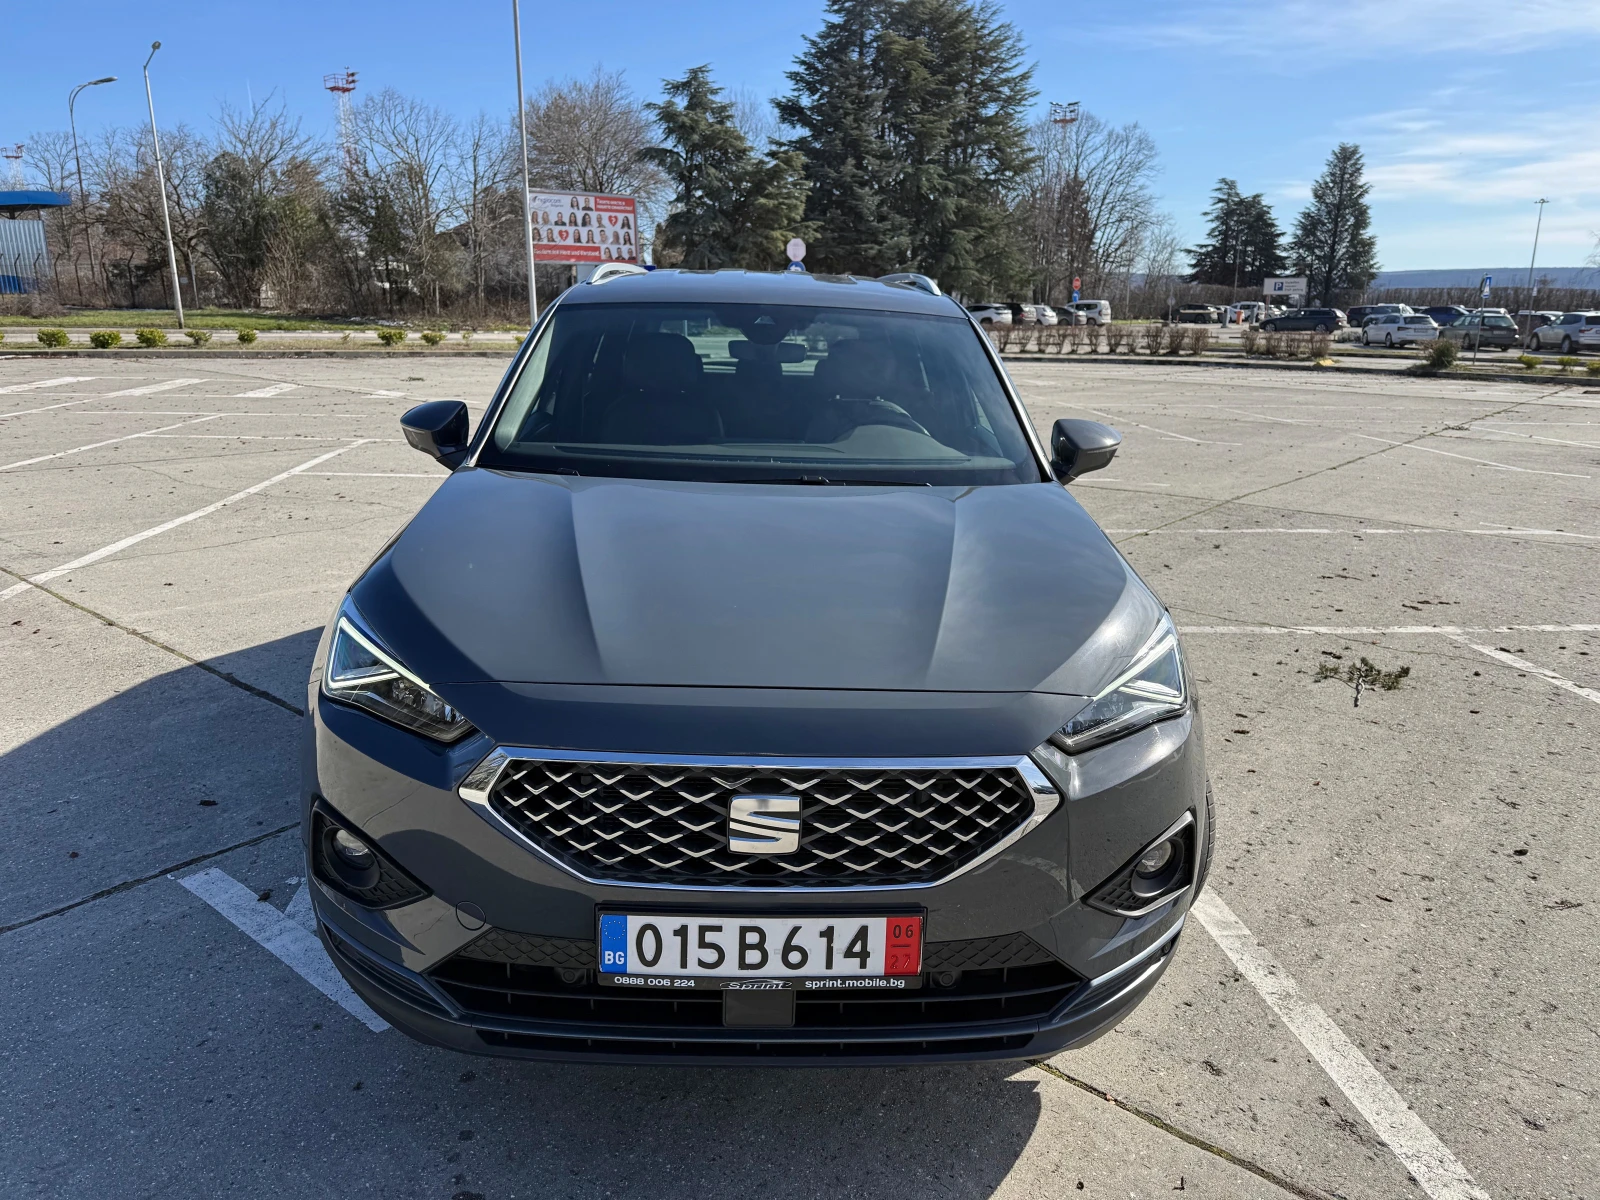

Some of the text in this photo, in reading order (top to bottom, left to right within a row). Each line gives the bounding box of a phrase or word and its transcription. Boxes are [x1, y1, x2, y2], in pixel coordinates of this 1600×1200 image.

[893, 924, 914, 939] 06
[636, 924, 871, 970] 015B614
[604, 951, 625, 965] BG
[890, 954, 911, 969] 27
[614, 976, 696, 987] 0888 006 224
[728, 982, 785, 990] Sprint
[805, 978, 906, 988] sprint.mobile.bg
